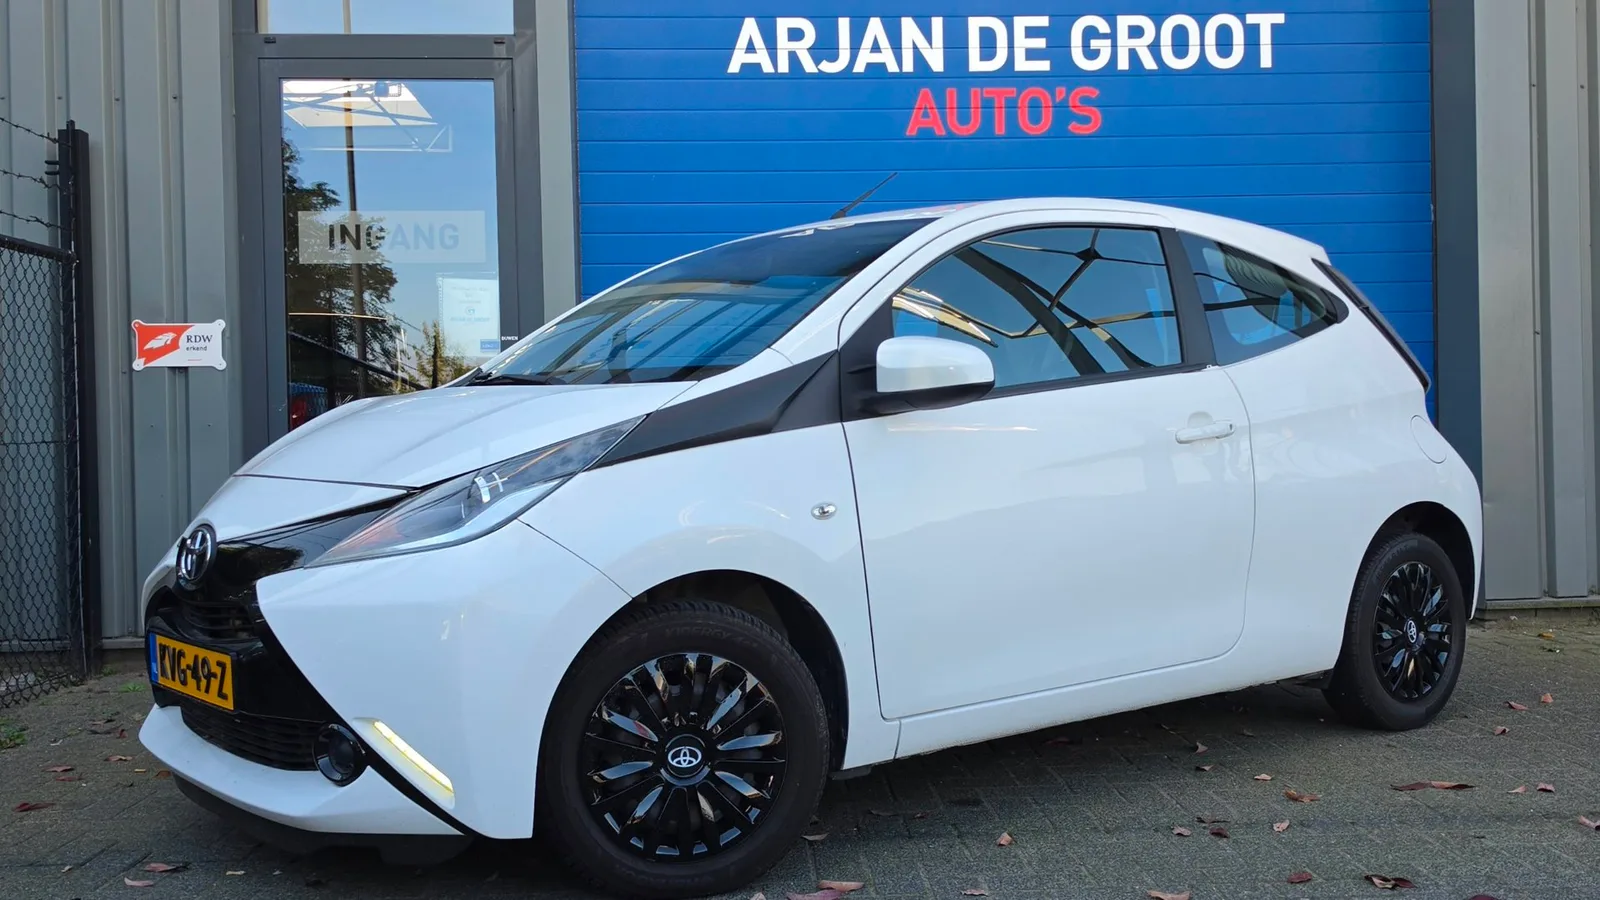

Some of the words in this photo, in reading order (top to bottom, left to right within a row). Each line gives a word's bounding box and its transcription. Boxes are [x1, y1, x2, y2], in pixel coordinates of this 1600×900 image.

[727, 16, 944, 74] ARJAN
[967, 16, 1051, 72] DE
[1070, 13, 1285, 71] GROOT
[906, 86, 1102, 136] AUTO'S
[328, 223, 459, 251] INGANG
[187, 335, 213, 343] RDW
[158, 643, 228, 700] KVG-49-Z
